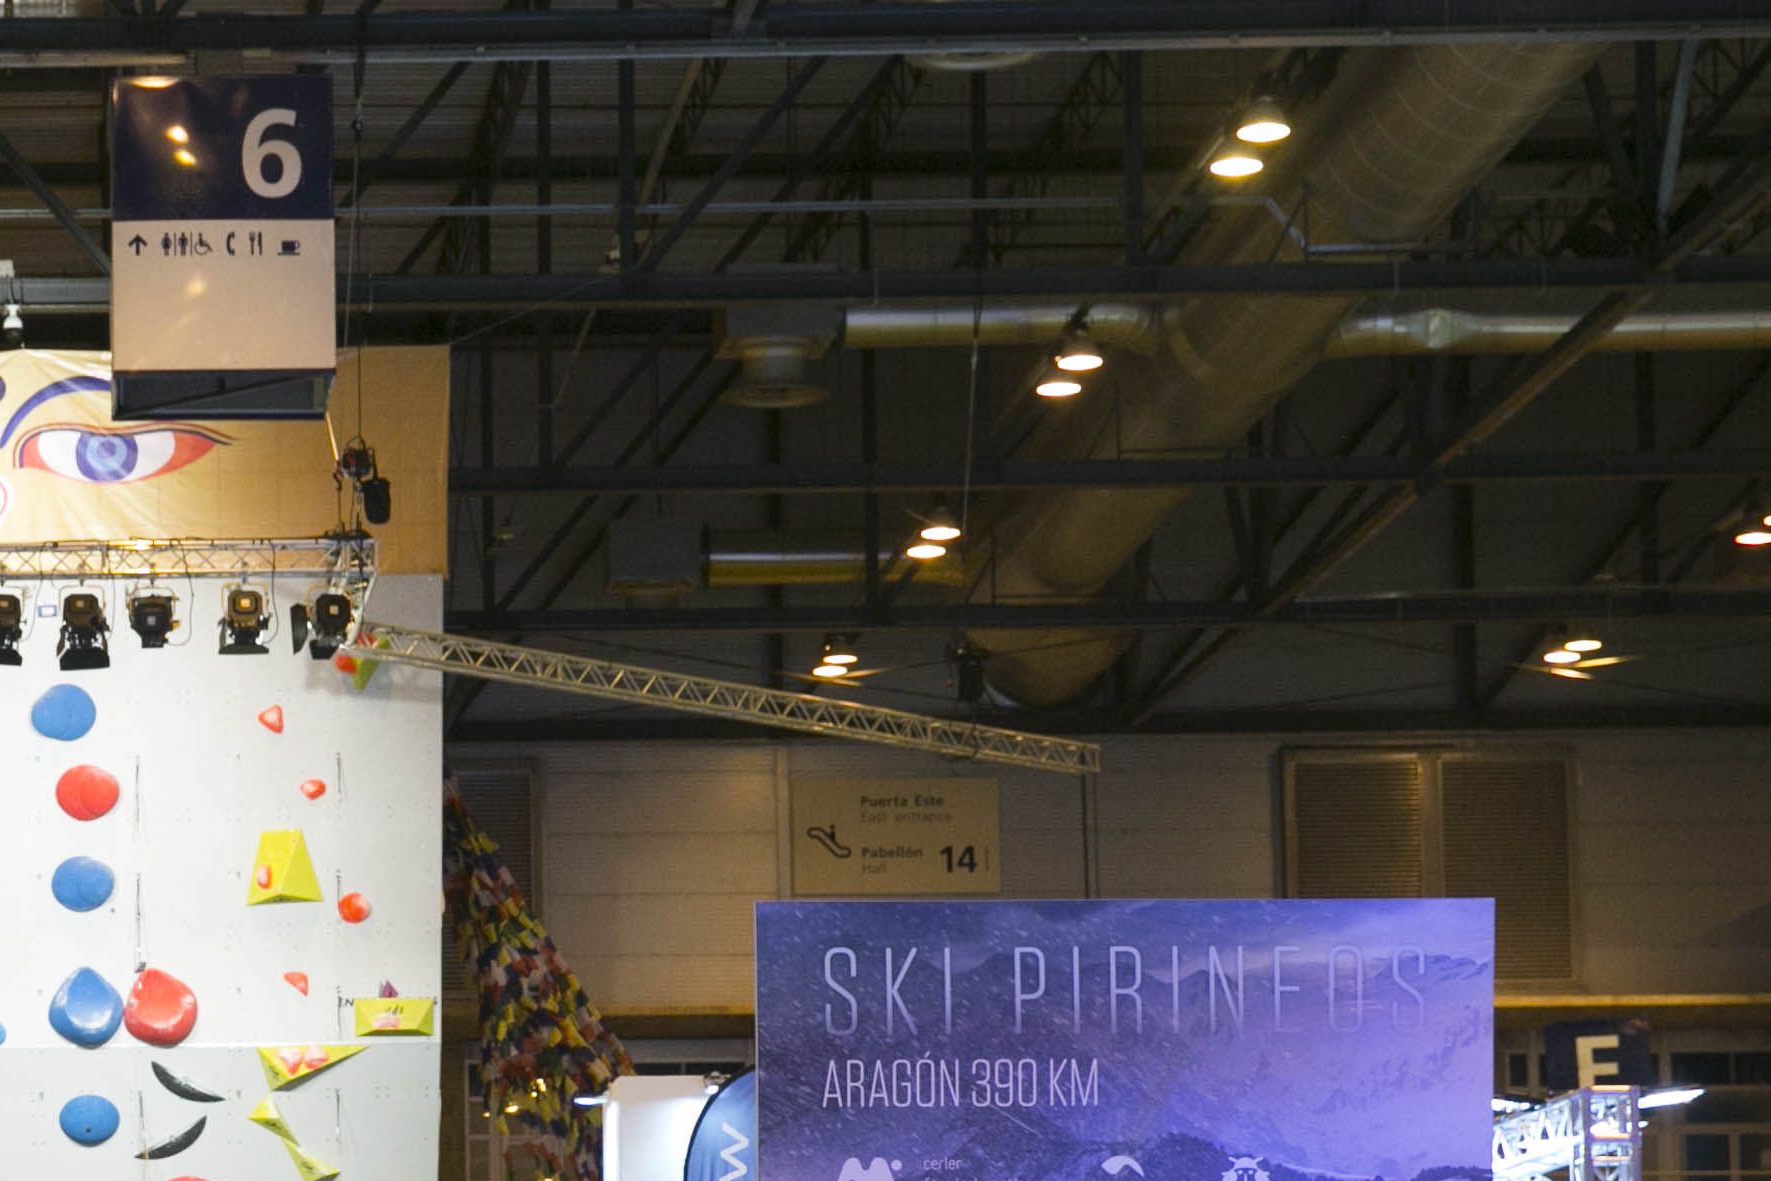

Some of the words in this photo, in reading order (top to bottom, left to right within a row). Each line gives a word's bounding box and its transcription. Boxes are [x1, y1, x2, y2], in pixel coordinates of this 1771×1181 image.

[241, 108, 303, 199] 6
[860, 795, 908, 808] Puerta
[915, 795, 944, 807] Este
[861, 846, 924, 859] Pabellón
[940, 845, 977, 873] 14
[823, 945, 953, 1037] SKI
[1012, 944, 1427, 1037] PIRINEOS
[821, 1052, 960, 1108] ARAGÓN
[971, 1057, 1038, 1108] 390
[1049, 1057, 1100, 1107] KM
[922, 1156, 963, 1171] cerler
